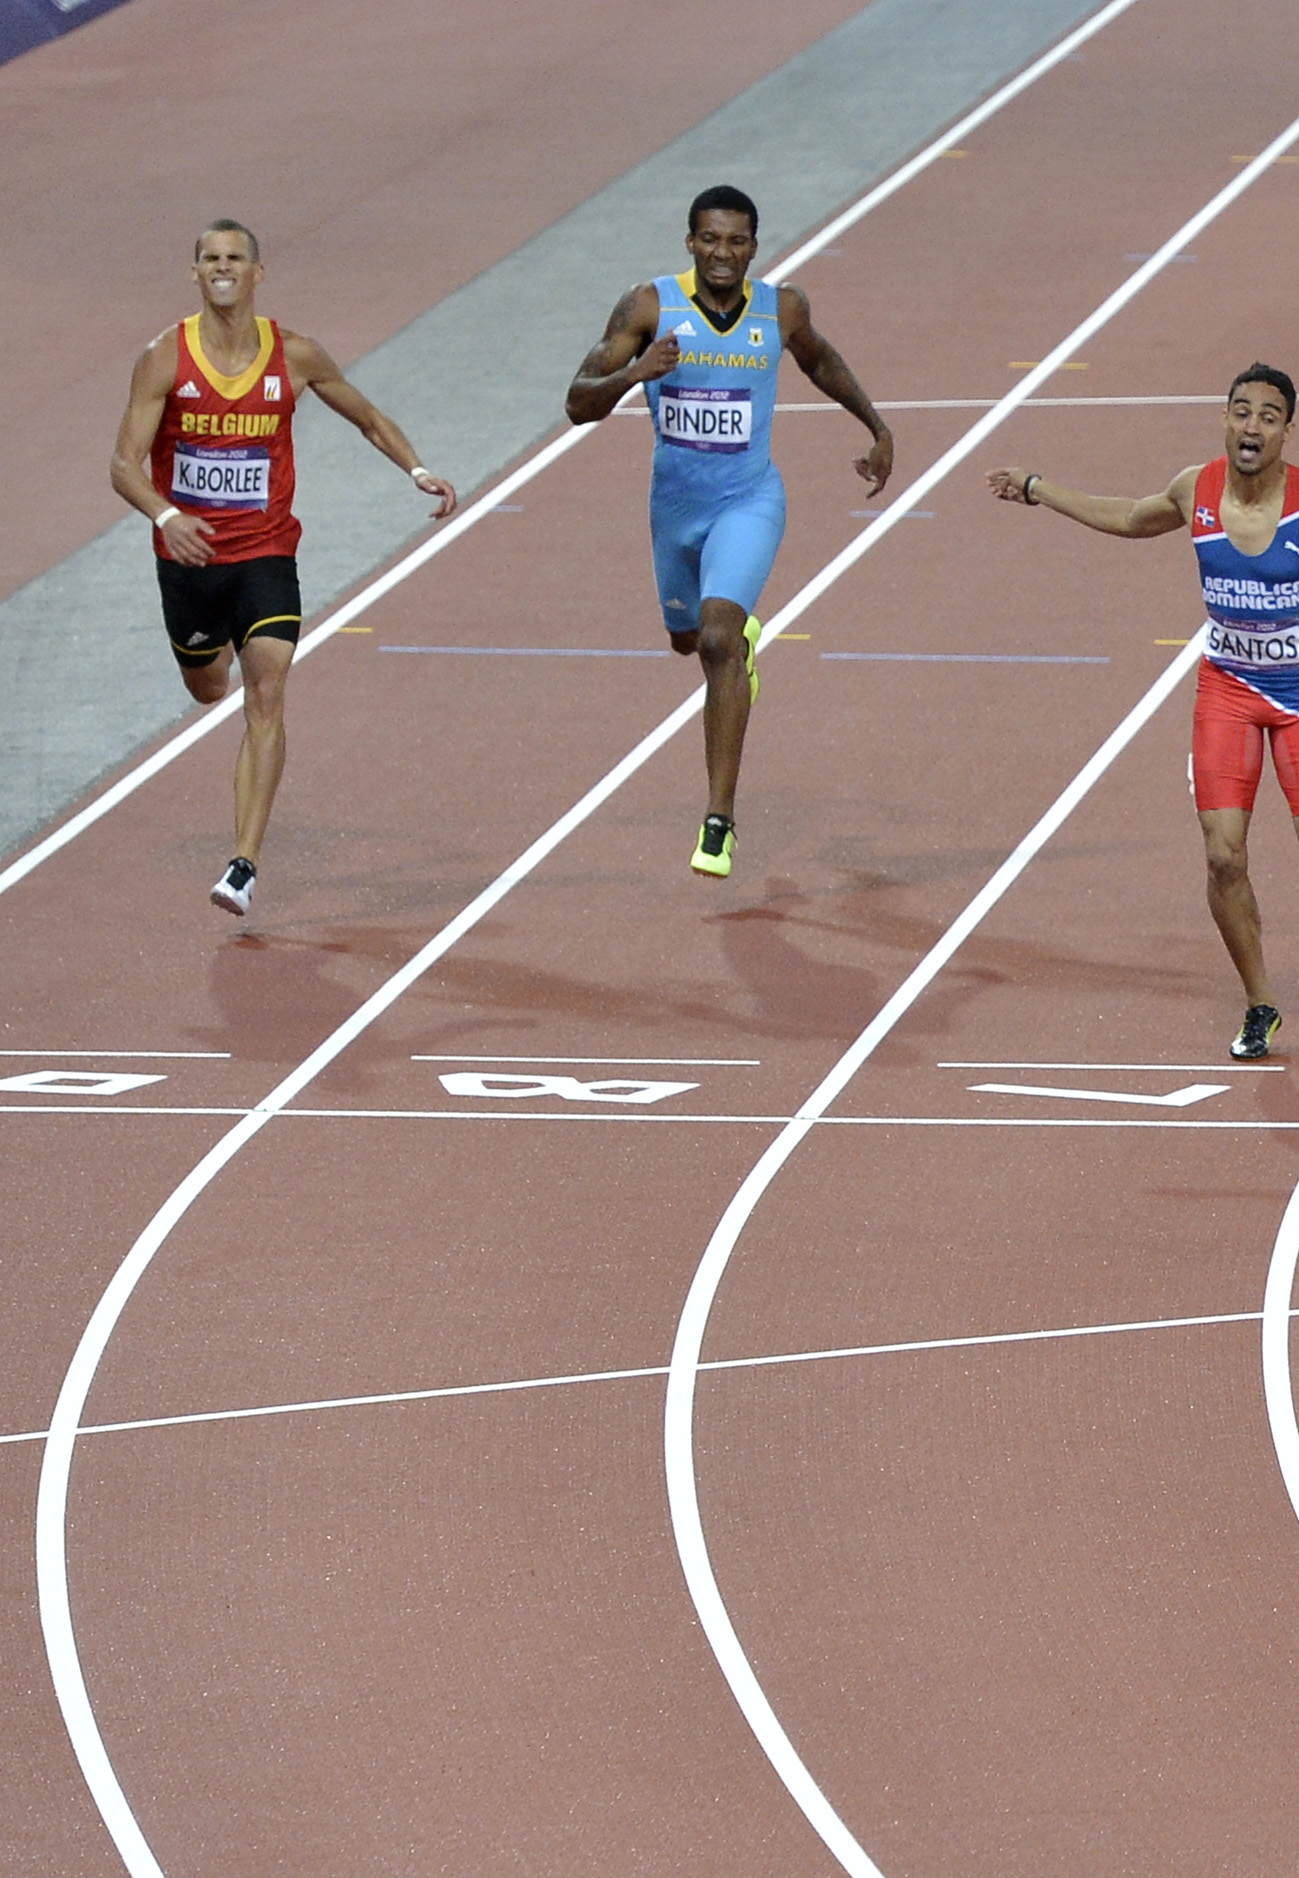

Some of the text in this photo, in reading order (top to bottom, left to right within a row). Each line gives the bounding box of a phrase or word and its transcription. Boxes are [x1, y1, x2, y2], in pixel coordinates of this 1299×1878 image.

[181, 412, 280, 437] BELGIUM
[665, 405, 743, 435] PINDER
[179, 461, 262, 493] K.BORLEE
[1209, 626, 1298, 661] SANTOS
